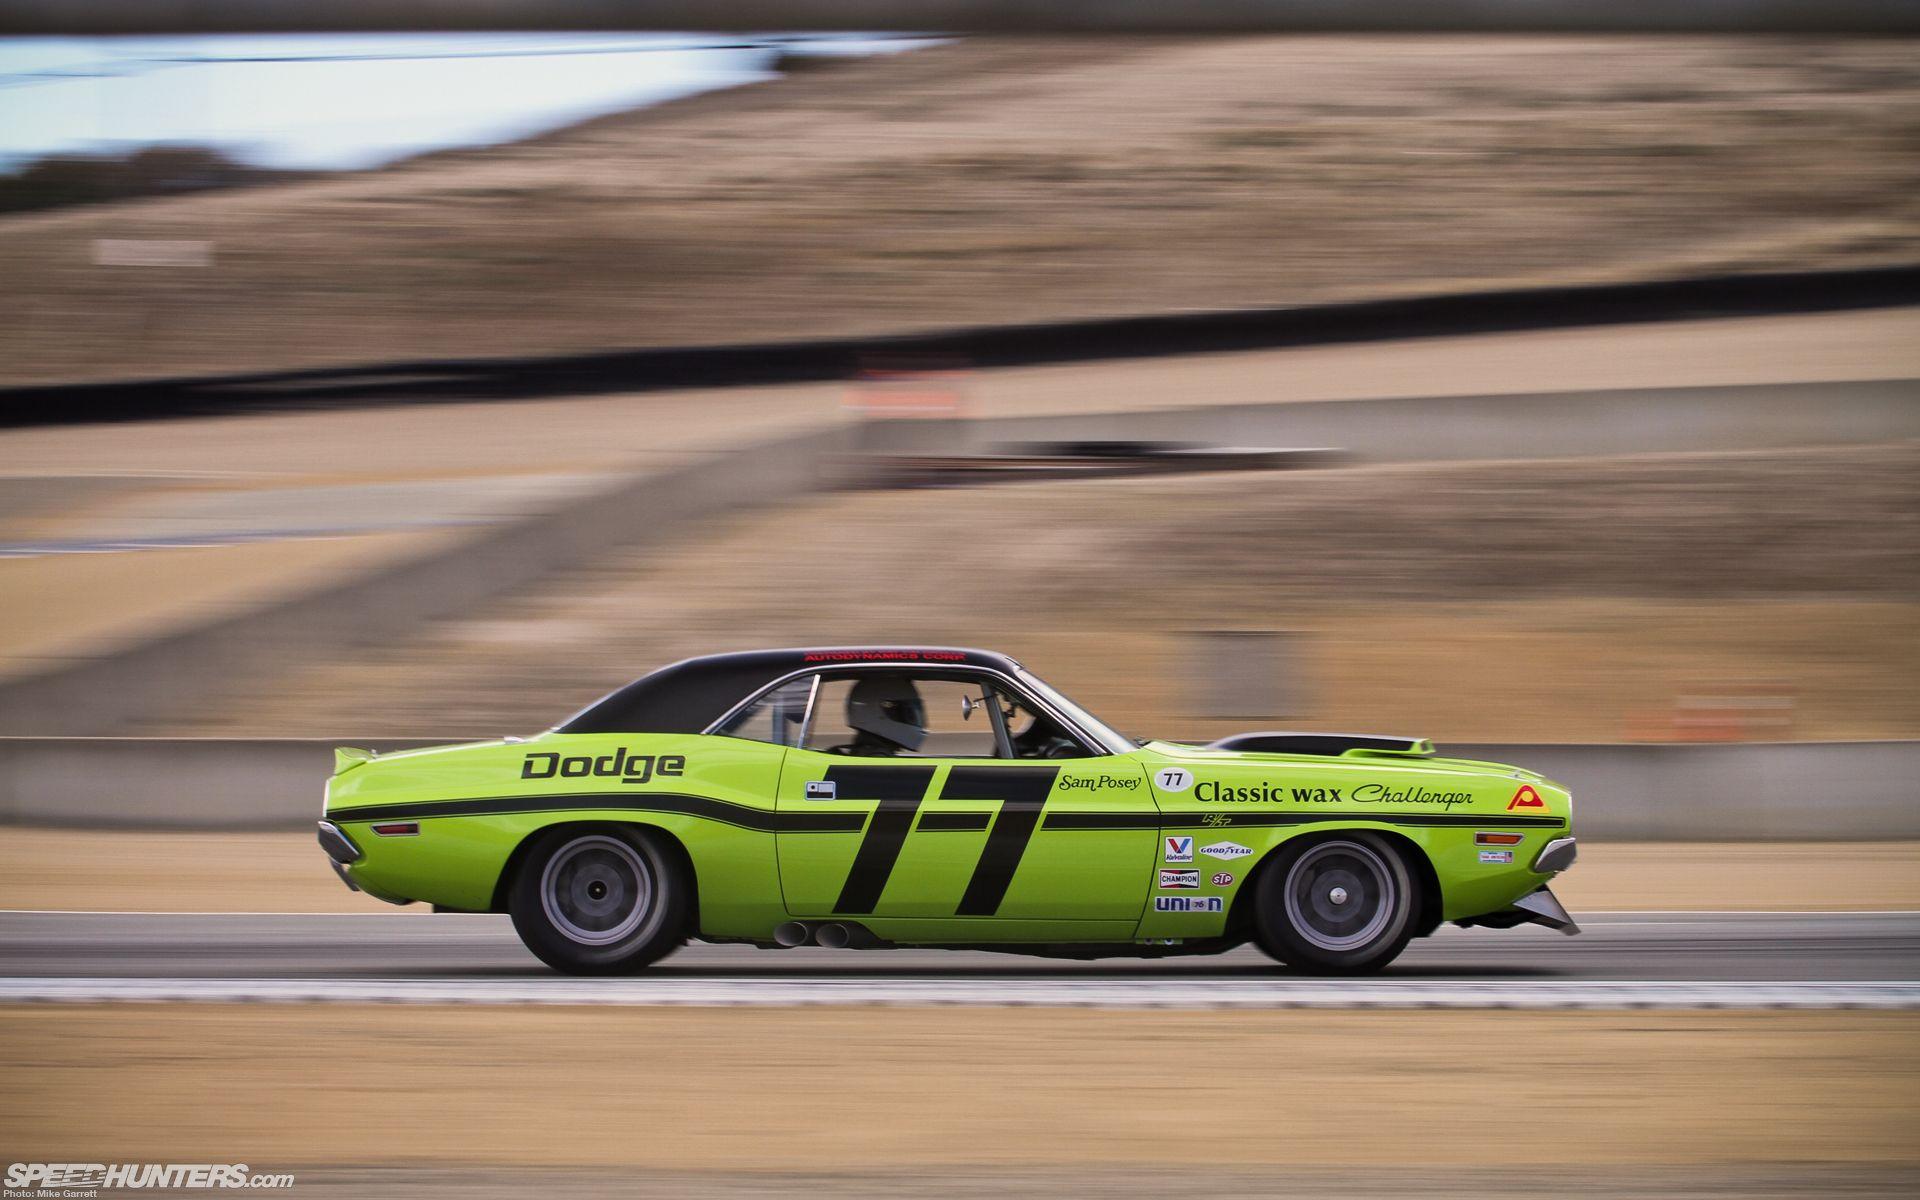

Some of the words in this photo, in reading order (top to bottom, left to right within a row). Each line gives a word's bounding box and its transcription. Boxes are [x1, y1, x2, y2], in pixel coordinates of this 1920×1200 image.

[804, 651, 919, 662] AUTODYNAMICS
[521, 747, 686, 784] Dodge
[1058, 774, 1096, 792] Sam
[1097, 774, 1142, 791] Posey
[1163, 772, 1184, 786] 77
[1194, 781, 1283, 803] Classic
[1291, 787, 1342, 803] wax
[1351, 783, 1474, 811] Challenger
[1202, 813, 1232, 828] R/T
[822, 765, 1061, 916] 77
[1200, 846, 1253, 855] GOODYEAR
[1161, 875, 1198, 883] CHAMPION
[1213, 873, 1232, 884] STP
